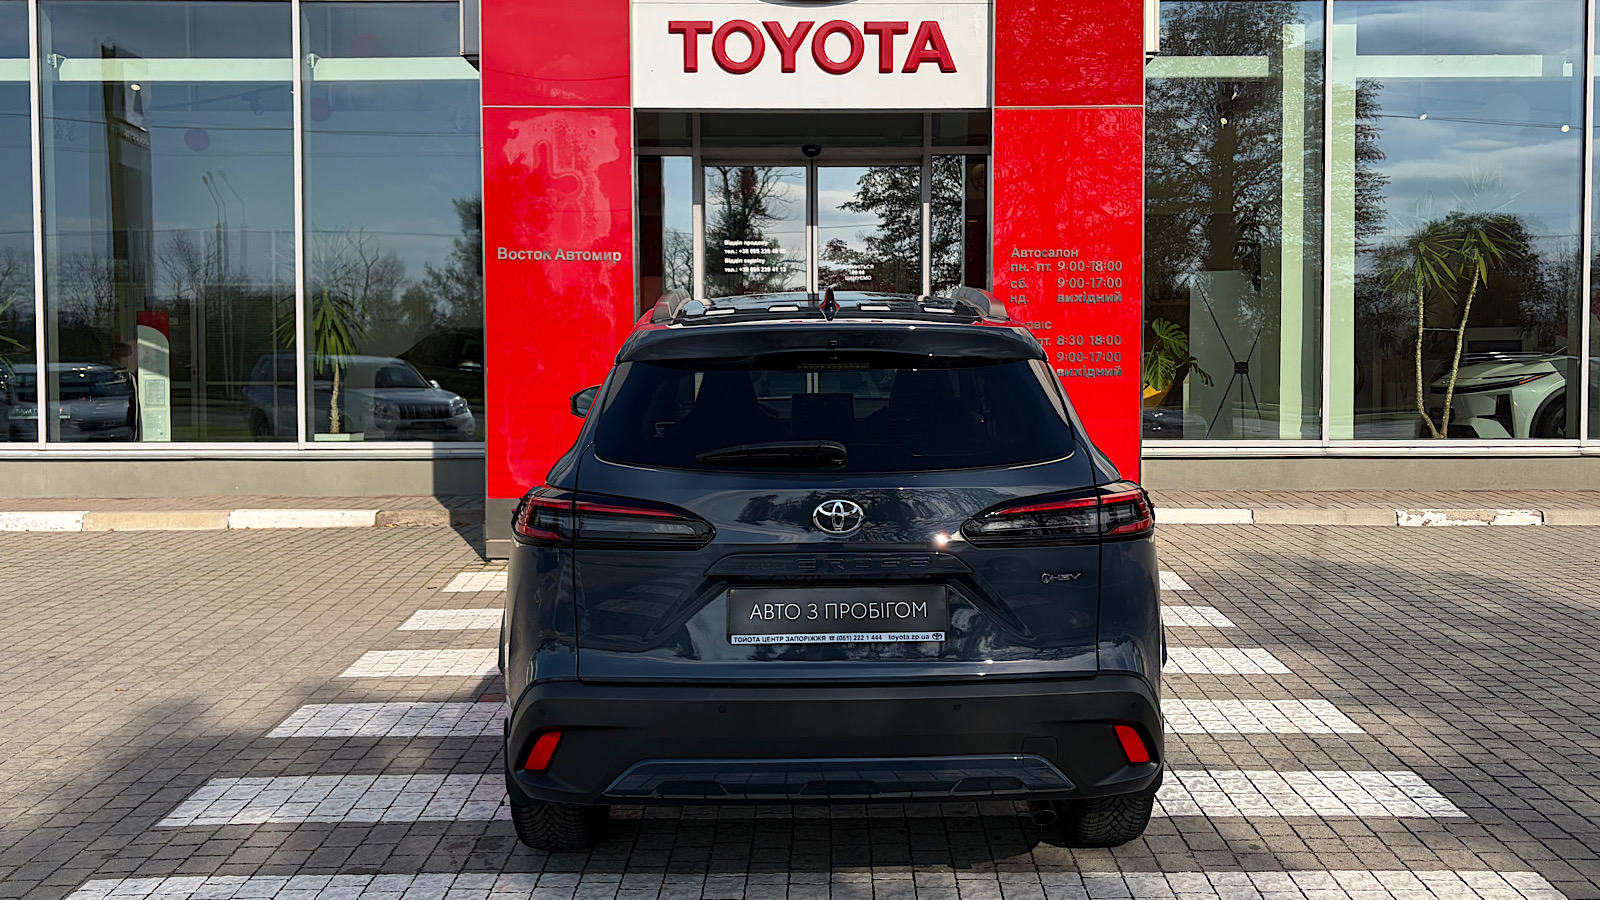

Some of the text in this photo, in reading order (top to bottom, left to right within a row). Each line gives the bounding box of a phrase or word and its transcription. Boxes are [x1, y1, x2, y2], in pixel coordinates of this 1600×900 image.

[668, 19, 958, 75] TOYOTA
[497, 247, 622, 265] Восток Автомир
[1011, 247, 1079, 259] Автосалон
[1057, 261, 1123, 272] 9:00-18:00
[1010, 278, 1123, 289] сб. 9:00-17:00
[1010, 291, 1123, 304] нд. вихідний
[1056, 352, 1122, 363] 9:00-17:00
[1056, 365, 1122, 378] вихідний
[749, 601, 928, 620] АВТО З ПРОБІГОМ
[733, 635, 761, 643] ТОЙОТА
[762, 635, 784, 643] ЦЕНТР
[888, 633, 930, 642] toyota.zp.ua
